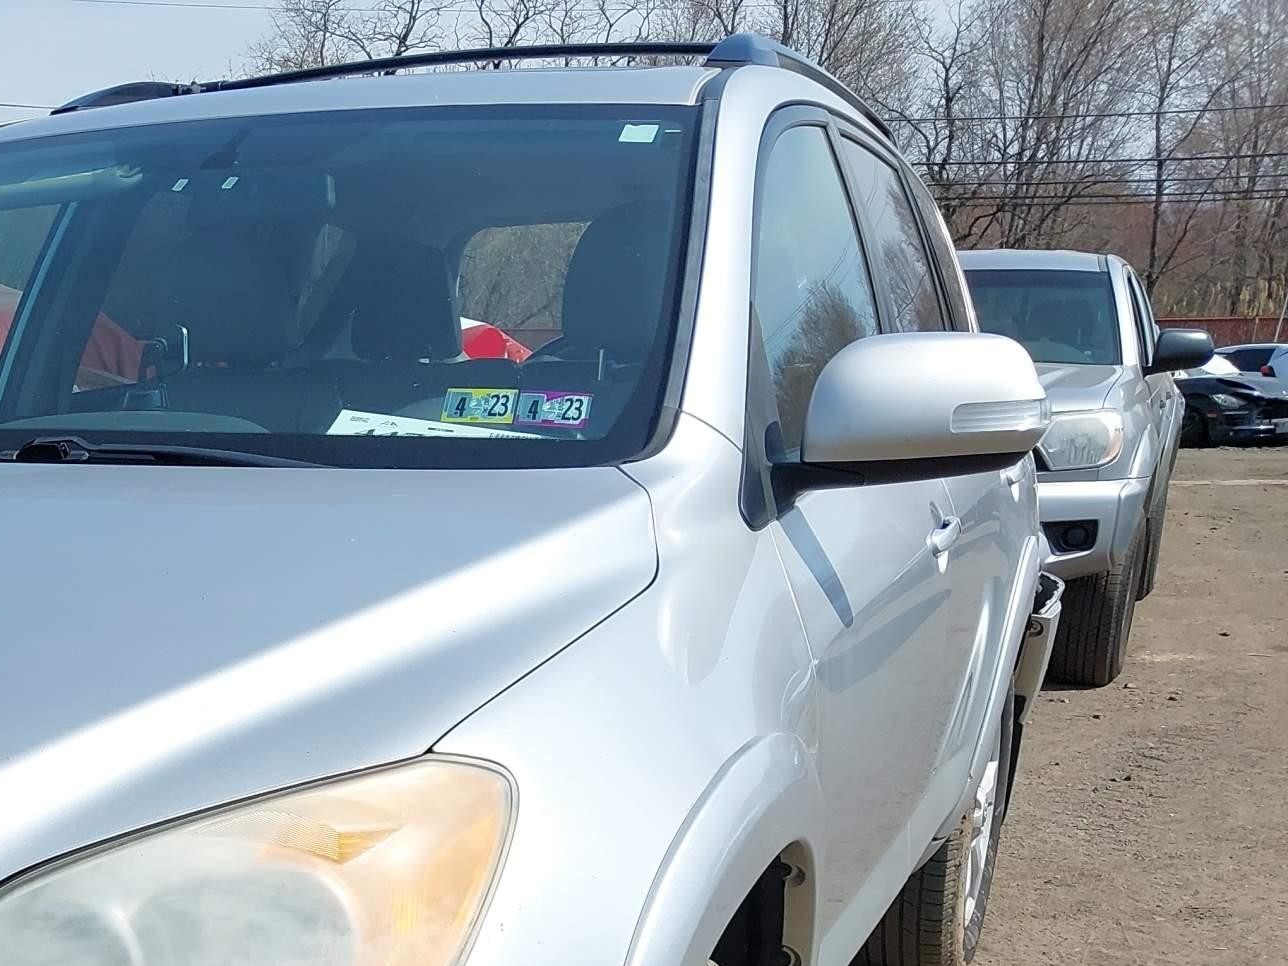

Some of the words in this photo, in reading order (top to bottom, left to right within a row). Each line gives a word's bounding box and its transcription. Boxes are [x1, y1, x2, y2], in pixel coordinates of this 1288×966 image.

[455, 397, 467, 417] 4
[487, 394, 510, 417] 23
[527, 400, 540, 420] 4
[562, 397, 584, 421] 23
